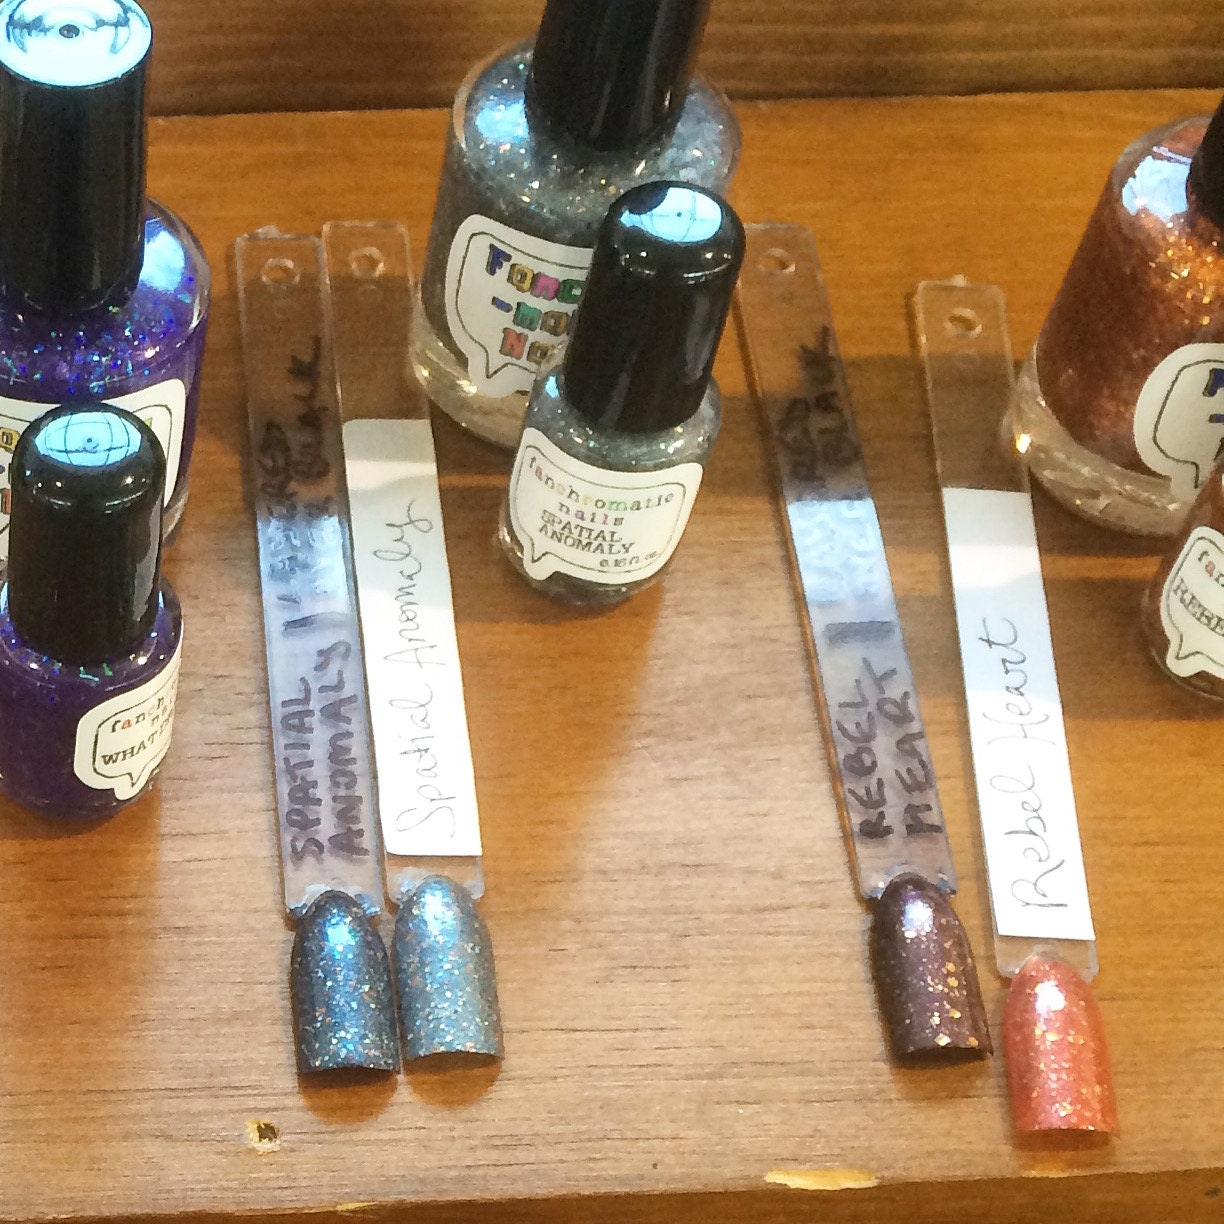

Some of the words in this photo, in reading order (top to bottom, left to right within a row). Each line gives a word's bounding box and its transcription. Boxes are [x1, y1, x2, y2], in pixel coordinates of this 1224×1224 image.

[539, 523, 636, 555] ANOMALY
[541, 509, 623, 543] SPATIAL
[558, 502, 624, 526] nails
[373, 498, 438, 670] Anomaly
[1173, 578, 1224, 637] REBE
[101, 730, 158, 766] WHAT
[862, 657, 944, 836] HEART
[977, 617, 1049, 745] Heart
[280, 676, 325, 862] SPATIAL
[395, 682, 457, 838] Spatial
[836, 679, 894, 839] REBEL
[981, 762, 1067, 909] Rebel
